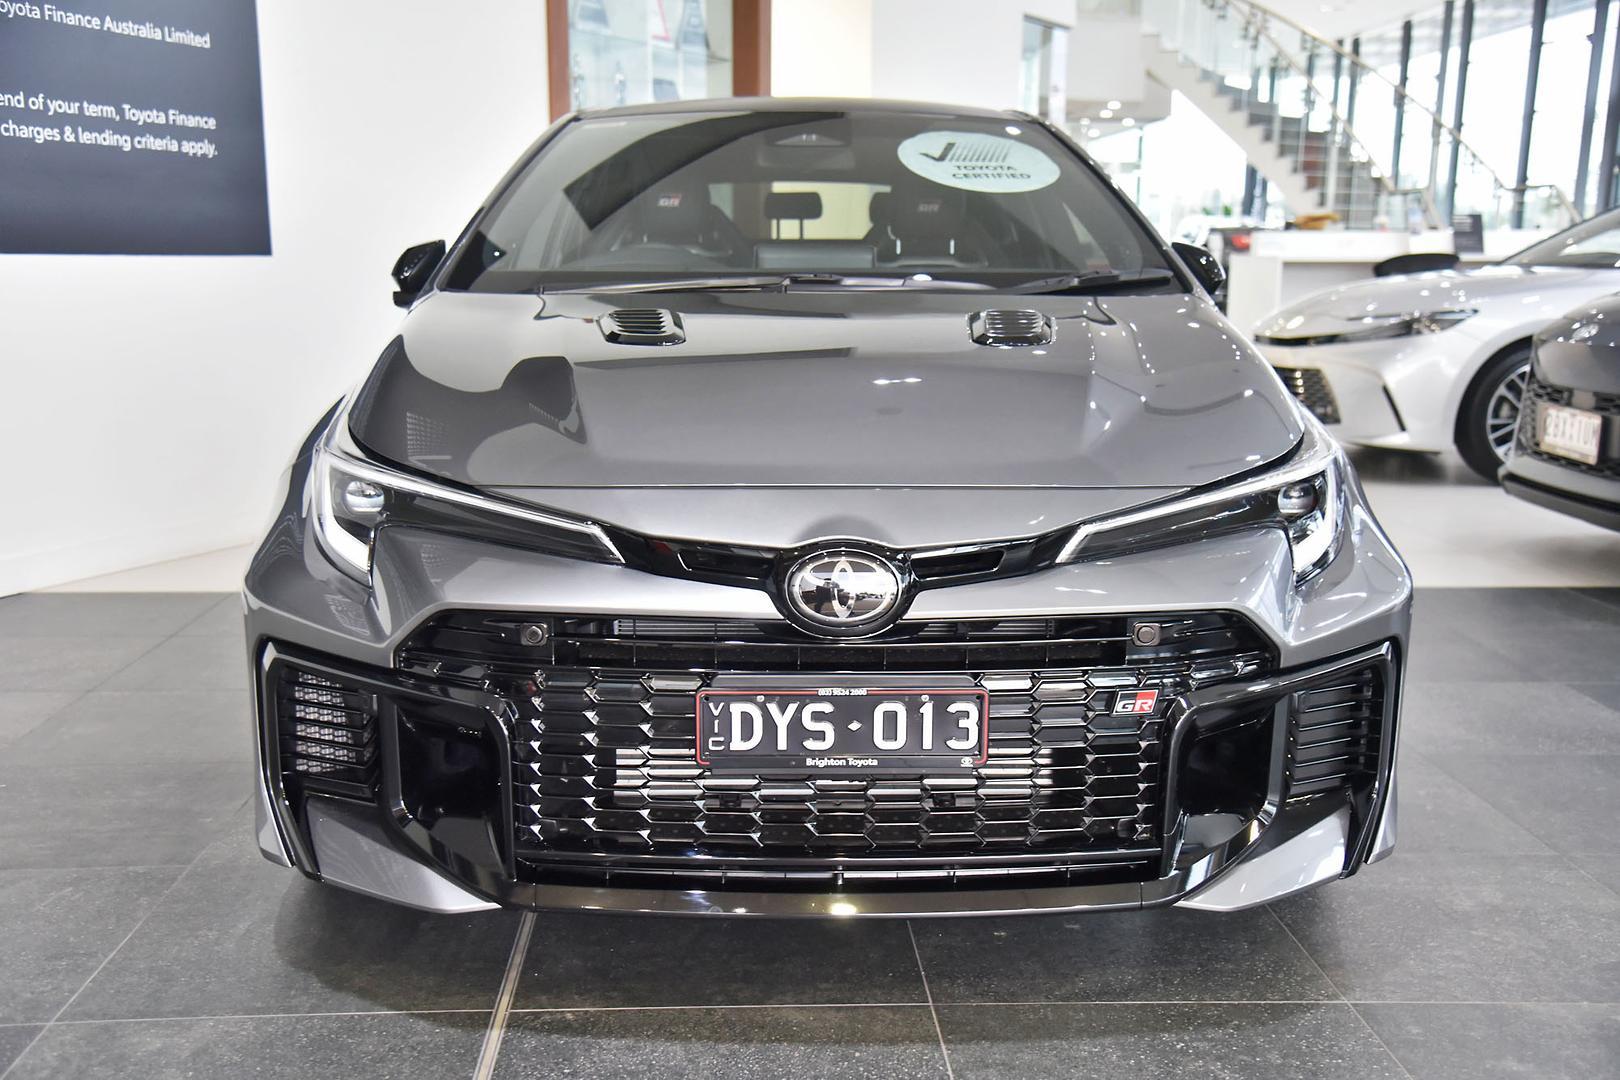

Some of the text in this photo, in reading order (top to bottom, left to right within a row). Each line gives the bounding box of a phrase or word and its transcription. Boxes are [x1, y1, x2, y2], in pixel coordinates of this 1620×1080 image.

[0, 0, 211, 48] oyota Finance Australia Limited
[0, 91, 217, 130] end of your term, Toyota Finance
[0, 119, 219, 158] charges & lending criteria apply.
[952, 172, 1032, 180] CERTIFIED
[1116, 699, 1154, 712] GR
[708, 702, 725, 751] VIC
[729, 701, 980, 751] DYS 013
[806, 757, 879, 768] Brighton Toyota
